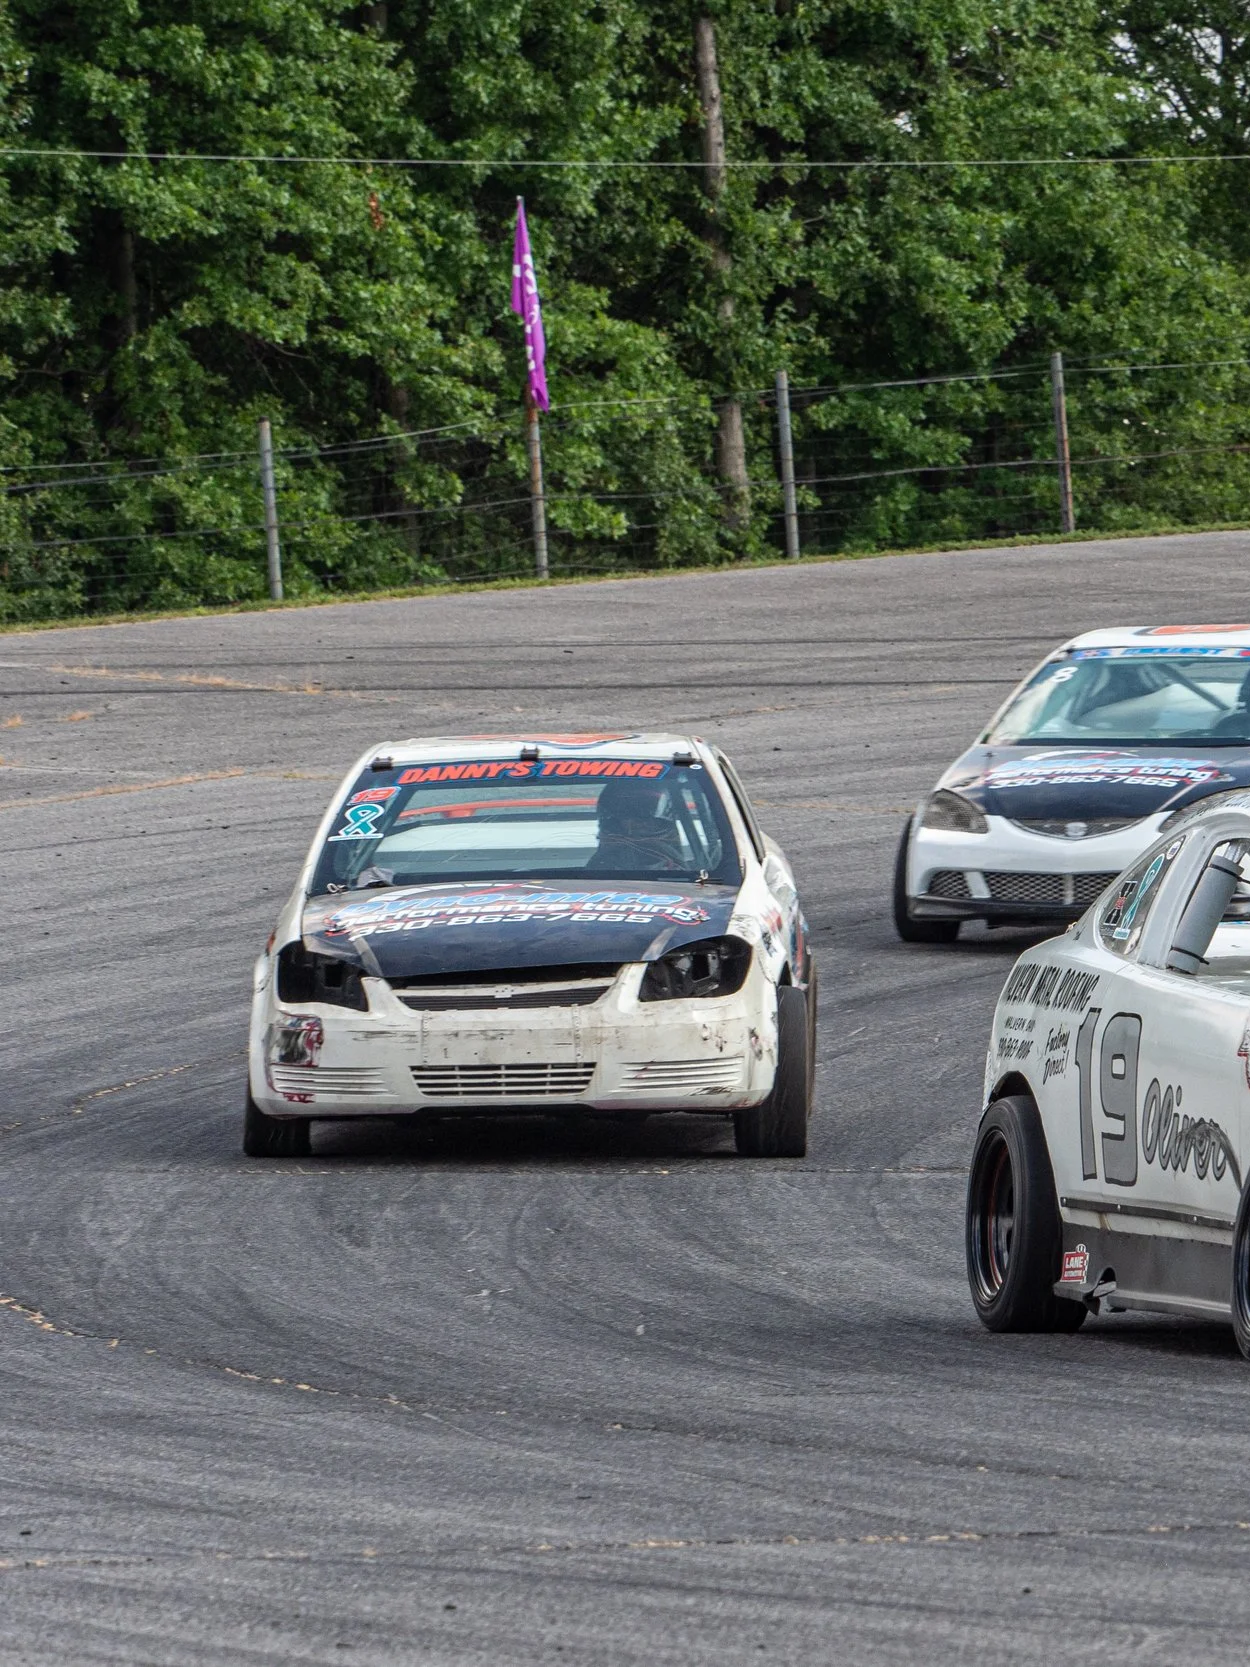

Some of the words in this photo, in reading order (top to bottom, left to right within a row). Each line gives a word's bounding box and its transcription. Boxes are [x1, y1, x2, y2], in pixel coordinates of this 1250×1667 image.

[1052, 666, 1079, 683] 8
[397, 761, 536, 785] DANNY'S
[541, 760, 666, 778] TOWING
[1138, 766, 1212, 782] tuning
[352, 787, 397, 803] 19
[336, 902, 569, 929] performance
[582, 902, 696, 922] tuning
[347, 912, 656, 942] 330-863-7665
[1050, 967, 1101, 1016] ROOFING
[1075, 1007, 1143, 1187] 19
[1142, 1077, 1228, 1182] Oliver
[1065, 1256, 1084, 1269] LANE
